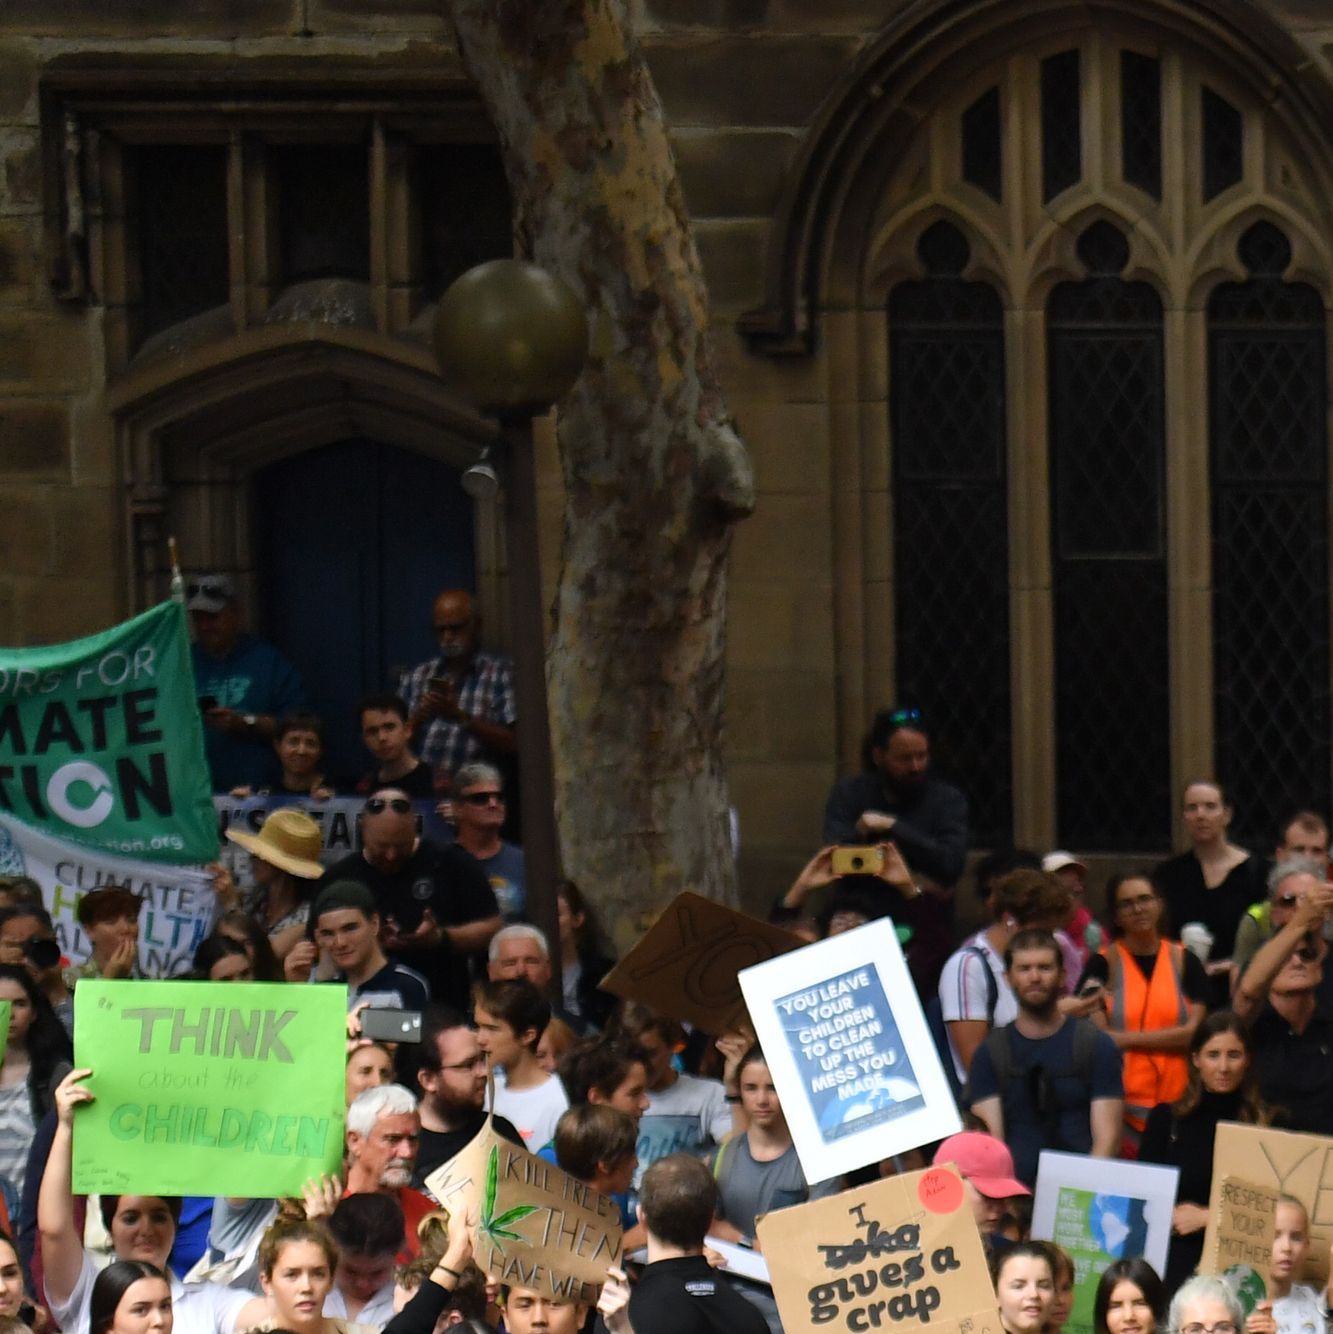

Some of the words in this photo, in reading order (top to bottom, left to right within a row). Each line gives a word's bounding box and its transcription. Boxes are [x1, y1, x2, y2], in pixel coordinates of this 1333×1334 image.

[75, 646, 156, 690] FOR
[782, 993, 822, 1015] YOU
[819, 972, 869, 1001] LEAVE
[808, 996, 854, 1023] YOUR
[799, 1005, 875, 1044] CHILDREN
[802, 1043, 826, 1061] TO
[828, 1021, 882, 1050] CLEAN
[811, 1067, 857, 1094] MESS
[859, 1050, 896, 1074] YOU
[820, 1055, 842, 1072] UP
[844, 1041, 875, 1063] THE
[137, 1066, 209, 1090] about
[224, 1066, 258, 1089] the
[837, 1073, 884, 1101] MADE
[108, 1102, 330, 1160] CHILDREN
[504, 1150, 551, 1192] KILL
[1224, 1183, 1278, 1213] RESPECT
[541, 1206, 622, 1263] THEN
[1231, 1211, 1266, 1238] YOUR
[930, 1245, 961, 1275] a
[1220, 1237, 1271, 1264] MOTHER
[488, 1248, 545, 1291] HAVE
[549, 1268, 602, 1302] WEE
[846, 1285, 941, 1334] crap
